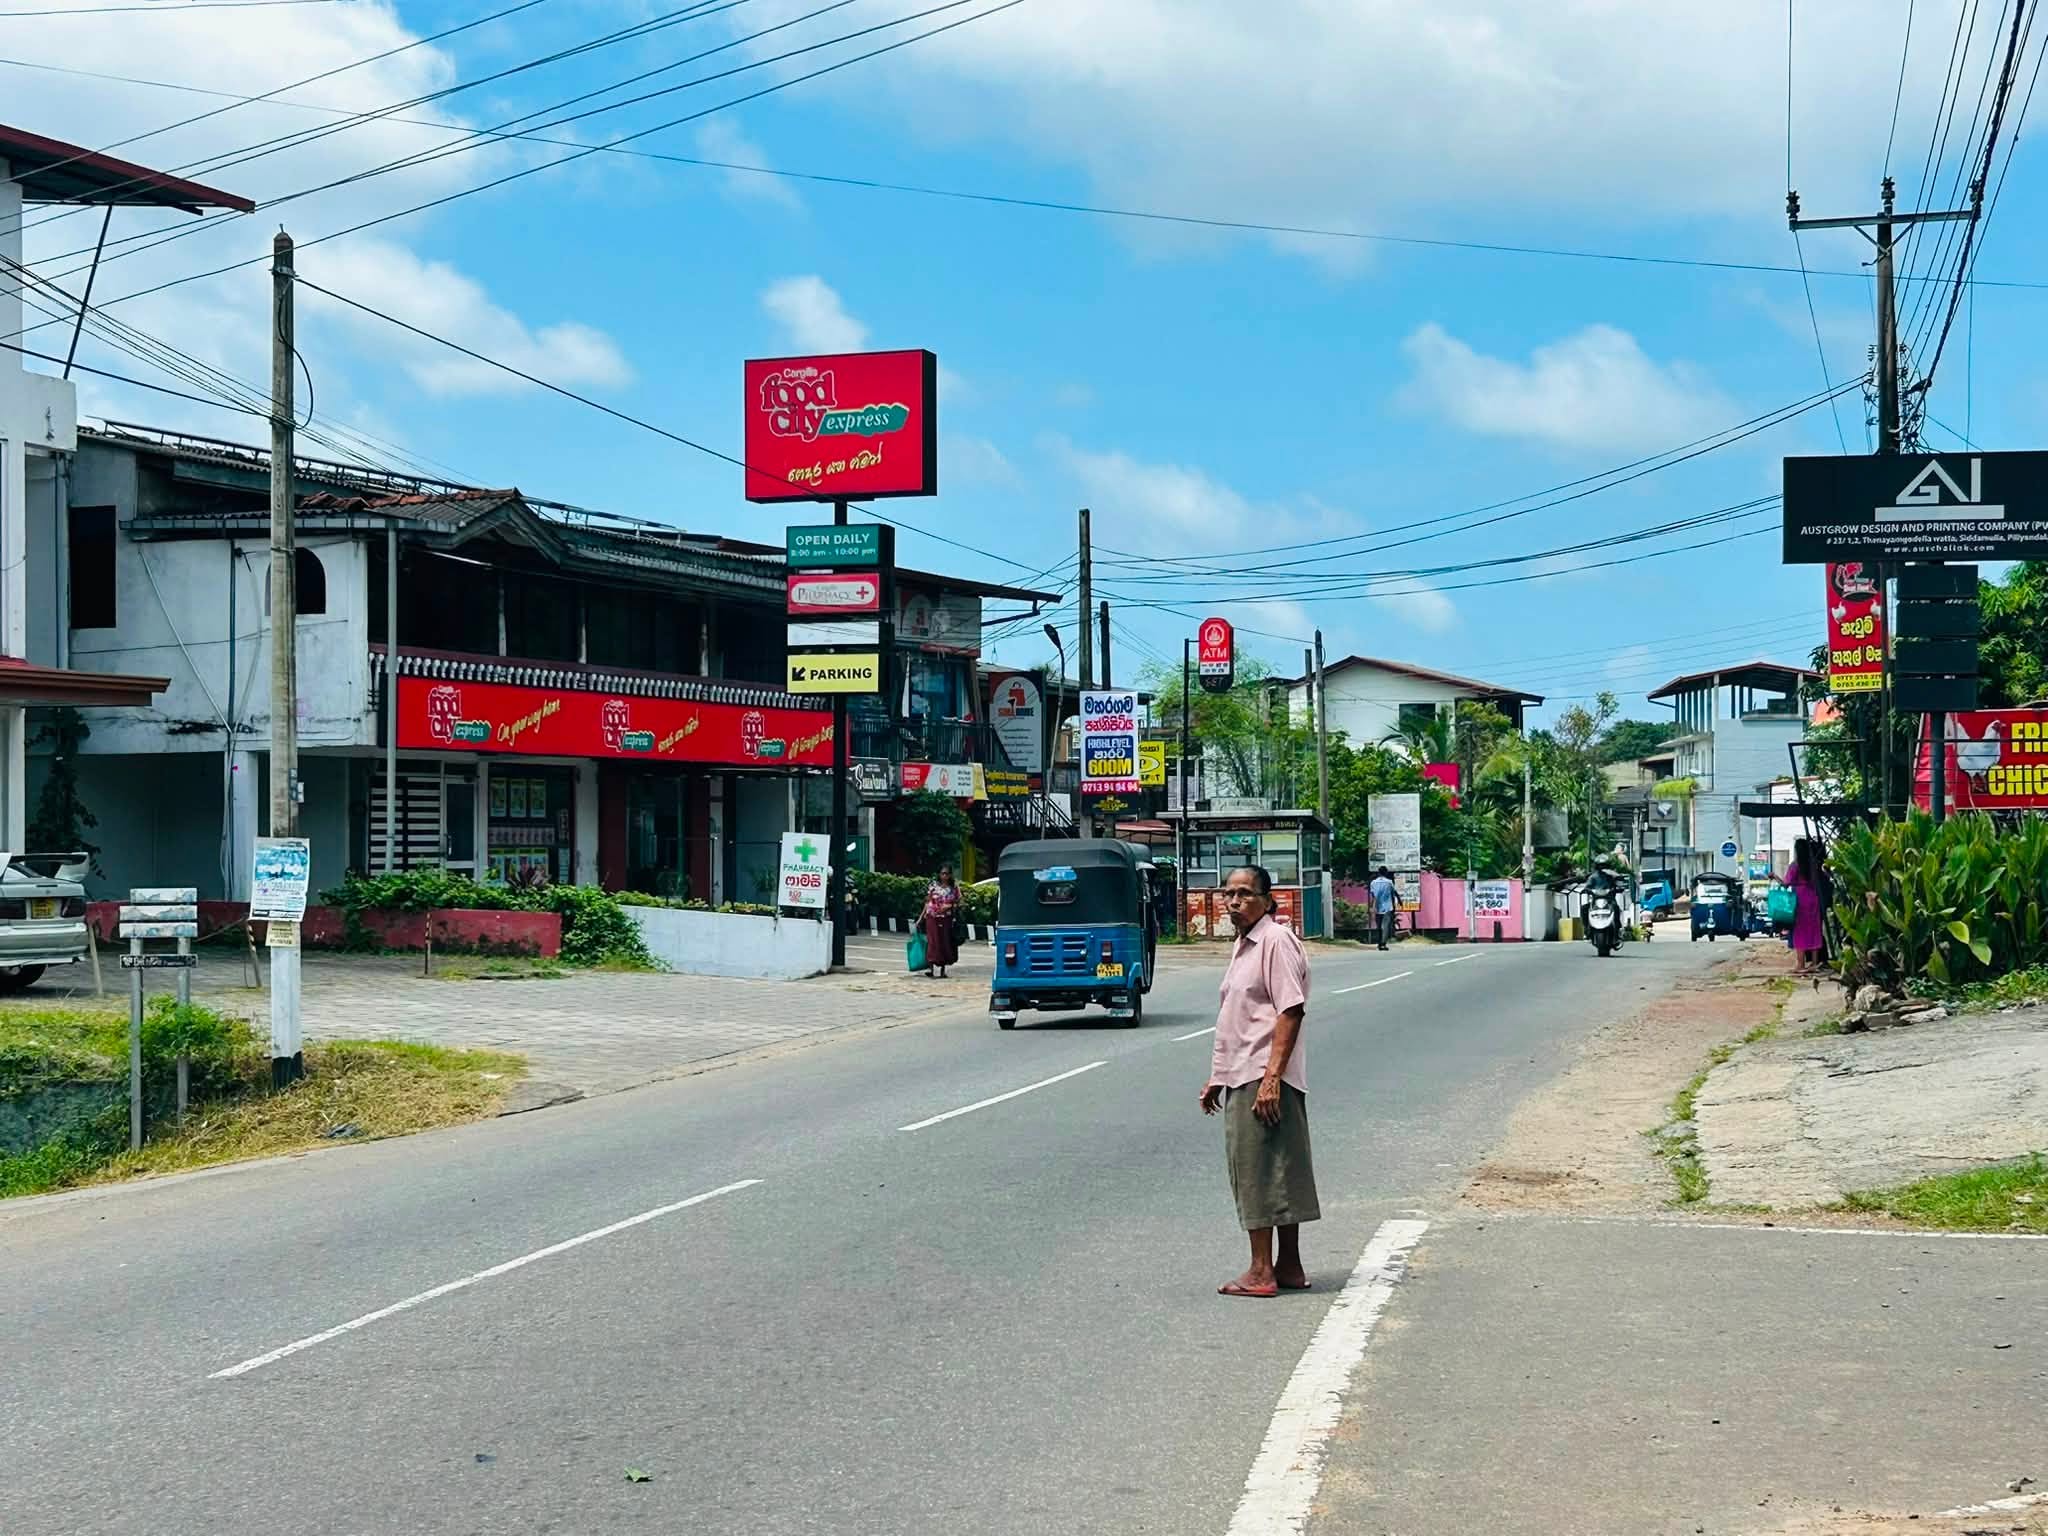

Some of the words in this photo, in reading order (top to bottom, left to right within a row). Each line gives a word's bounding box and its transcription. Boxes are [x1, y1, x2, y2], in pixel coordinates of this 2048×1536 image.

[761, 370, 837, 411] food
[826, 412, 891, 433] express
[1801, 525, 1859, 535] AUSTGROW
[1861, 524, 1899, 533] DESIGN
[1902, 523, 1924, 532] AND
[1926, 522, 1976, 532] PRINTING
[1977, 521, 2029, 531] COMPANY
[795, 535, 830, 546] OPEN
[833, 533, 870, 545] DAILY
[834, 547, 859, 556] 10:00
[1202, 647, 1227, 659] ATM
[810, 667, 873, 681] PARKING
[1085, 695, 1134, 714] මහරගම
[1087, 737, 1132, 749] HIGHLEVEL
[1088, 758, 1132, 776] 600M
